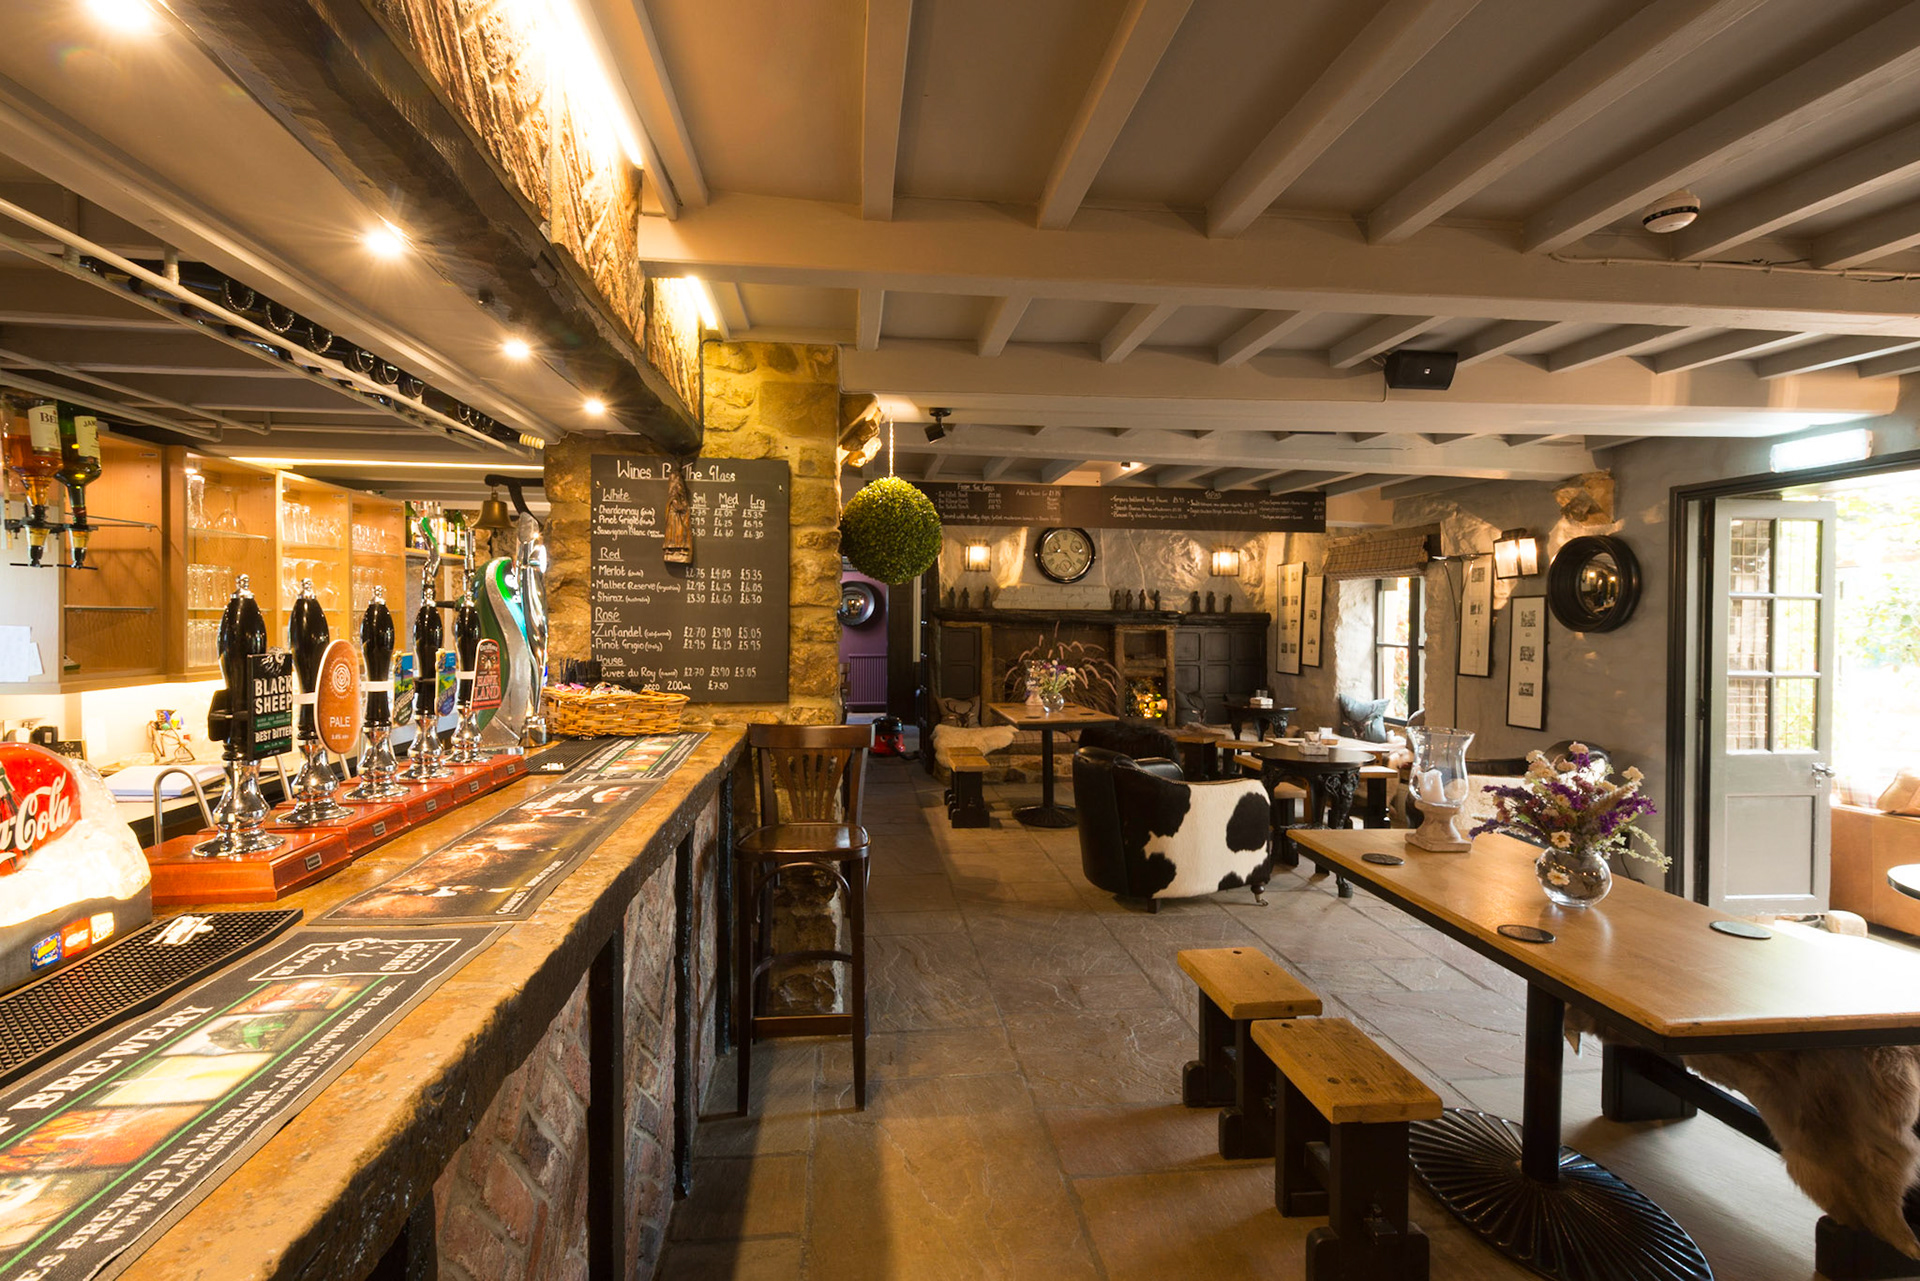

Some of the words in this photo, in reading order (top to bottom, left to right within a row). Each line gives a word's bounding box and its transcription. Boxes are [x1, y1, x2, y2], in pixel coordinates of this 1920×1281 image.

[617, 460, 651, 478] Wines
[662, 463, 672, 479] B
[682, 462, 702, 480] The
[709, 465, 736, 482] Glass
[602, 489, 630, 501] White
[693, 492, 707, 503] Sml
[719, 493, 739, 504] Med
[750, 494, 766, 508] Lrg
[599, 505, 639, 518] Chardonnay
[599, 515, 618, 524] Pinot
[691, 517, 706, 525] 2.95
[629, 528, 646, 536] Blanc
[600, 547, 620, 559] Red
[599, 565, 626, 576] Merlot
[596, 579, 626, 590] Malbec
[627, 581, 656, 591] Reserve
[597, 591, 624, 602] Shiraz
[595, 607, 620, 621] Rosé
[594, 623, 642, 641] Zinfandel
[683, 626, 706, 638] £2.70
[595, 637, 620, 650] Pinot
[622, 638, 645, 654] Grigio
[628, 668, 639, 678] du
[641, 666, 656, 683] Roy
[254, 675, 292, 696] BLACK
[474, 686, 500, 700] LAND
[254, 693, 292, 715] SHEEP
[330, 717, 351, 727] PALE
[254, 729, 271, 743] BEST
[272, 726, 292, 740] BITTER
[271, 946, 333, 976] BLACK
[380, 943, 430, 971] SHEEP
[7, 1005, 214, 1112] BREWERY
[14, 1253, 66, 1281] ES
[56, 1168, 170, 1250] BREWED
[162, 1140, 197, 1166] IN
[190, 1089, 272, 1146] MASHAM
[276, 1053, 312, 1079] AND
[302, 1008, 373, 1056] NOWHERE
